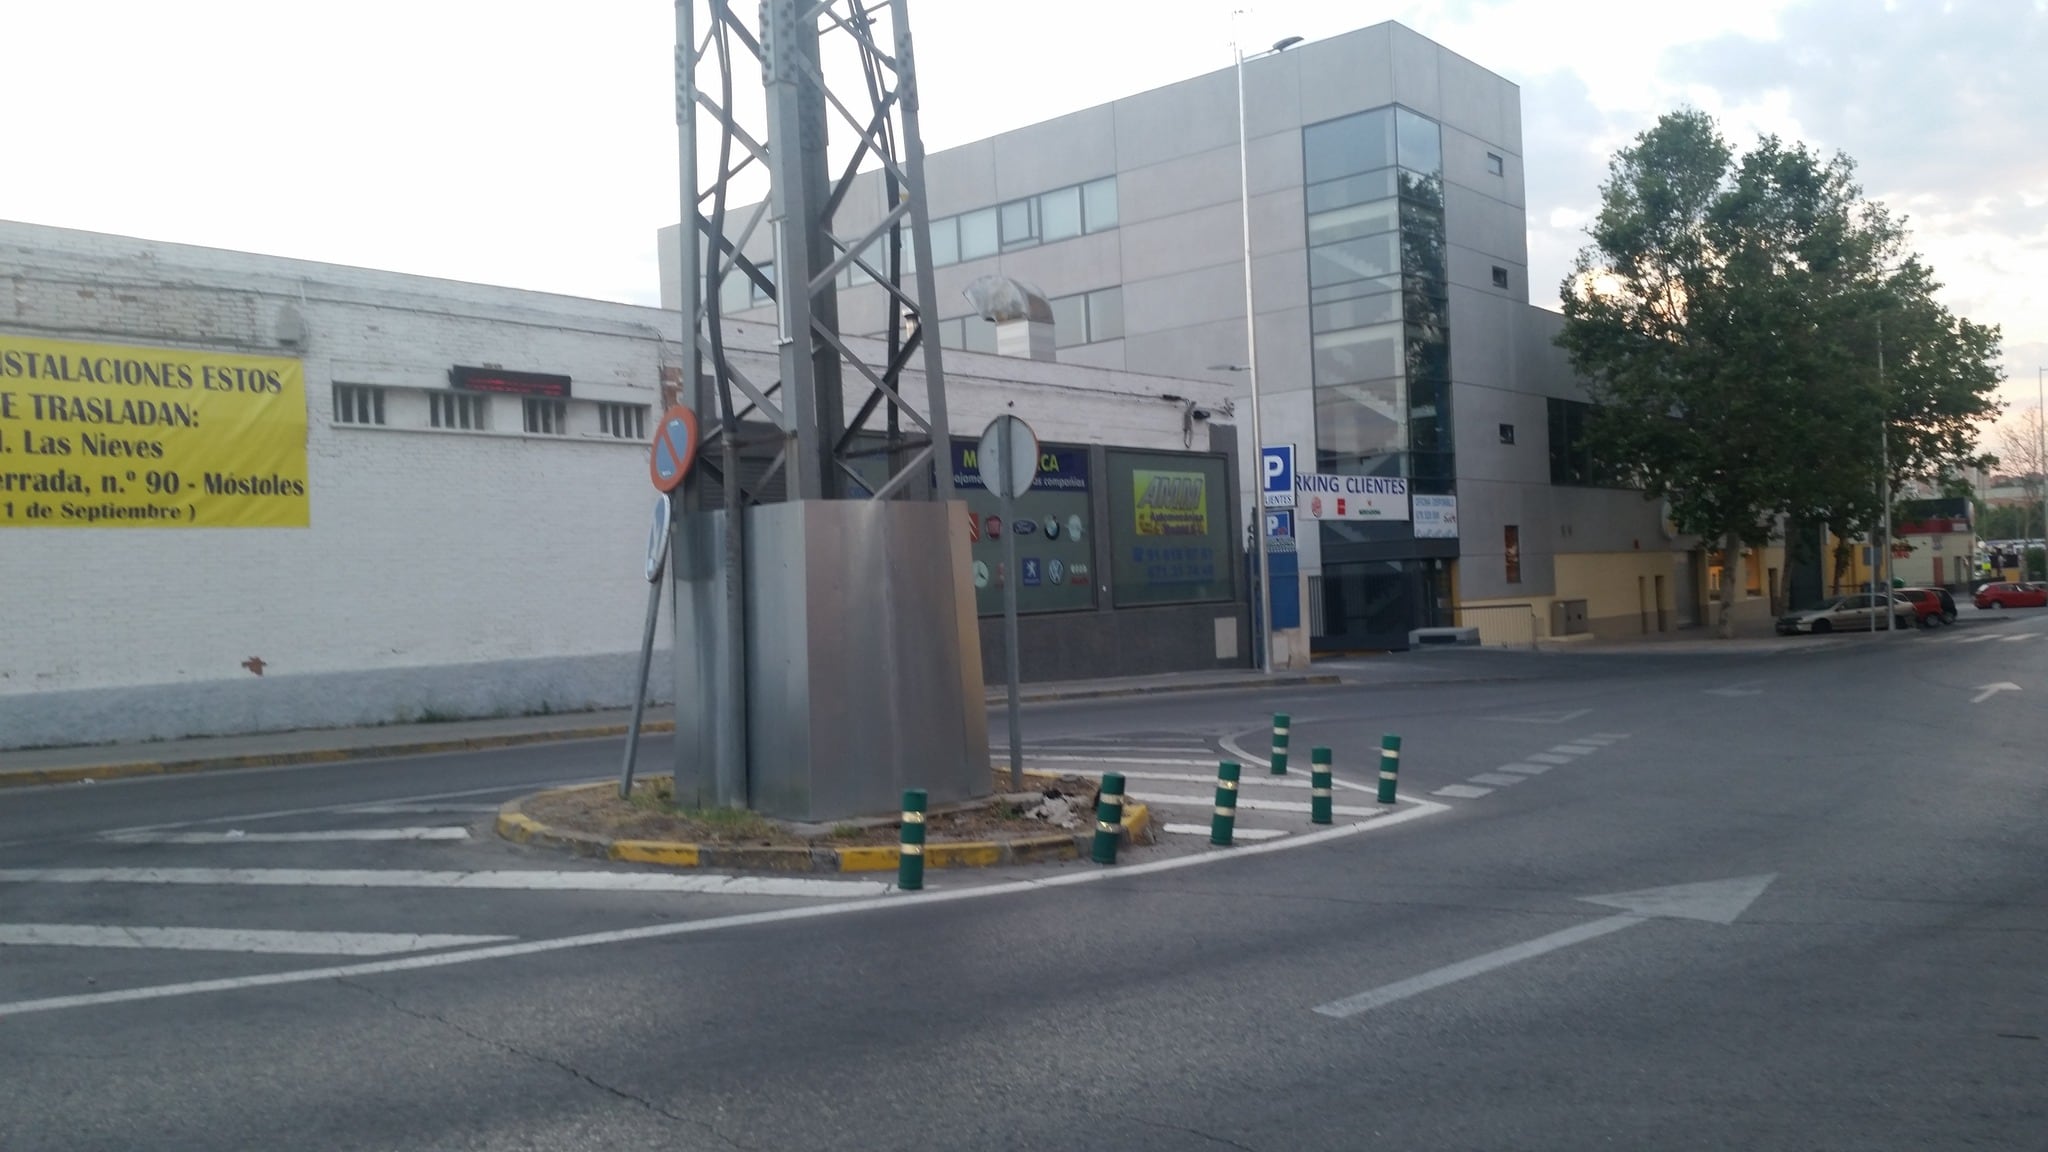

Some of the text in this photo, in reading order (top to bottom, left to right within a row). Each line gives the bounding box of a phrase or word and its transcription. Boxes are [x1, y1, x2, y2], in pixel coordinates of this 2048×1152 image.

[202, 366, 282, 394] ESTOS
[28, 393, 199, 428] TRASLADAN:
[24, 429, 72, 456] Las
[81, 432, 164, 459] Nieves
[0, 468, 91, 497] rrada,
[145, 471, 180, 495] 90
[204, 472, 305, 497] Móstoles
[1264, 455, 1284, 489] P
[1346, 476, 1406, 495] CLIENTES
[26, 502, 52, 518] de
[60, 502, 182, 522] Septiembre
